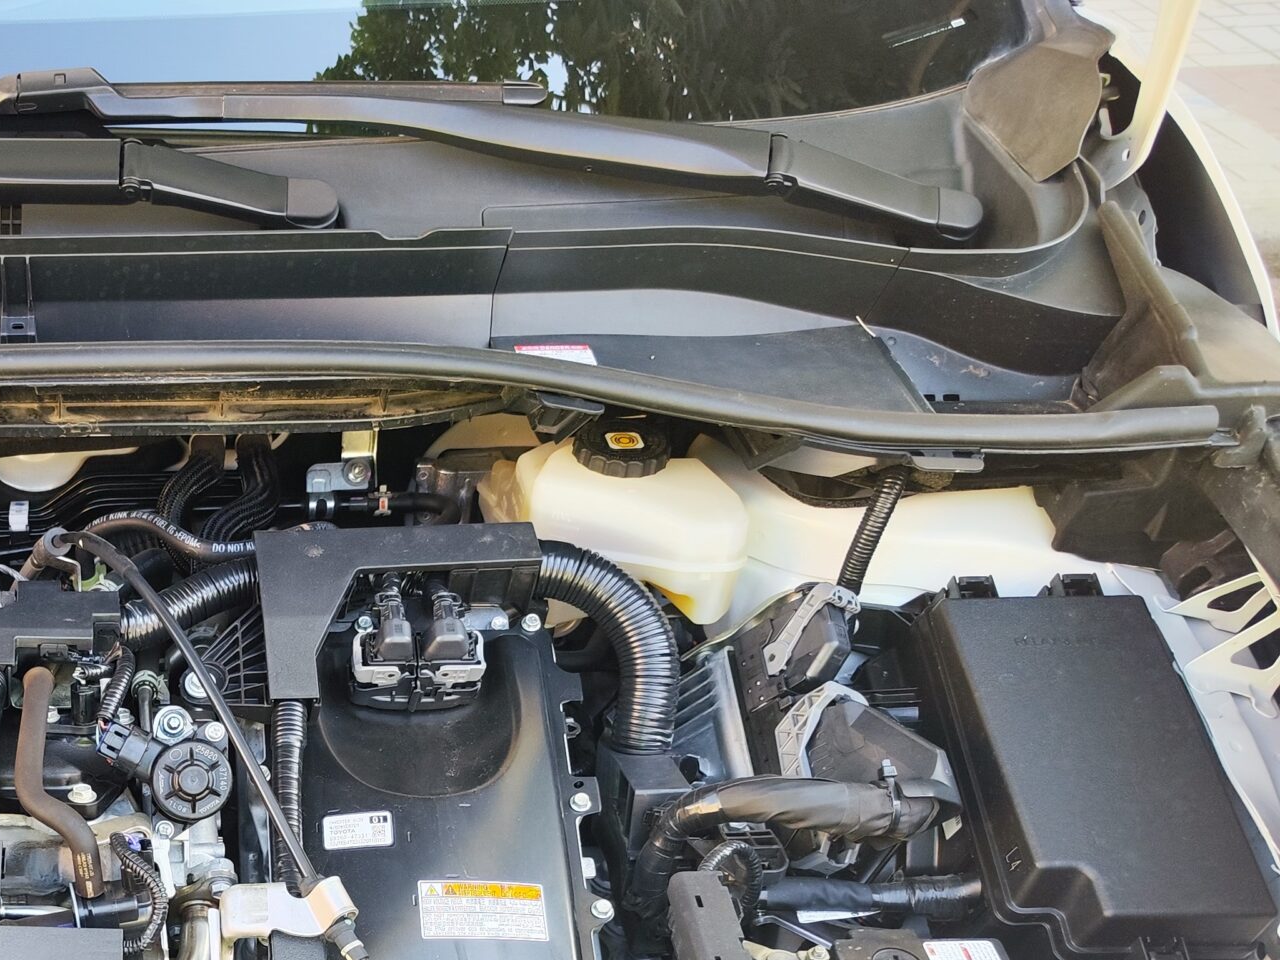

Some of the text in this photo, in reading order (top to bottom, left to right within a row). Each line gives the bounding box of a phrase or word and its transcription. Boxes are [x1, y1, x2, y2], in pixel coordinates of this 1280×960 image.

[108, 511, 129, 521] KINK
[152, 515, 168, 530] FUEL
[212, 542, 225, 553] DO
[227, 542, 244, 553] NOT
[219, 767, 229, 792] 37140
[199, 799, 220, 815] TOYOTA
[329, 829, 356, 837] TOYOTA
